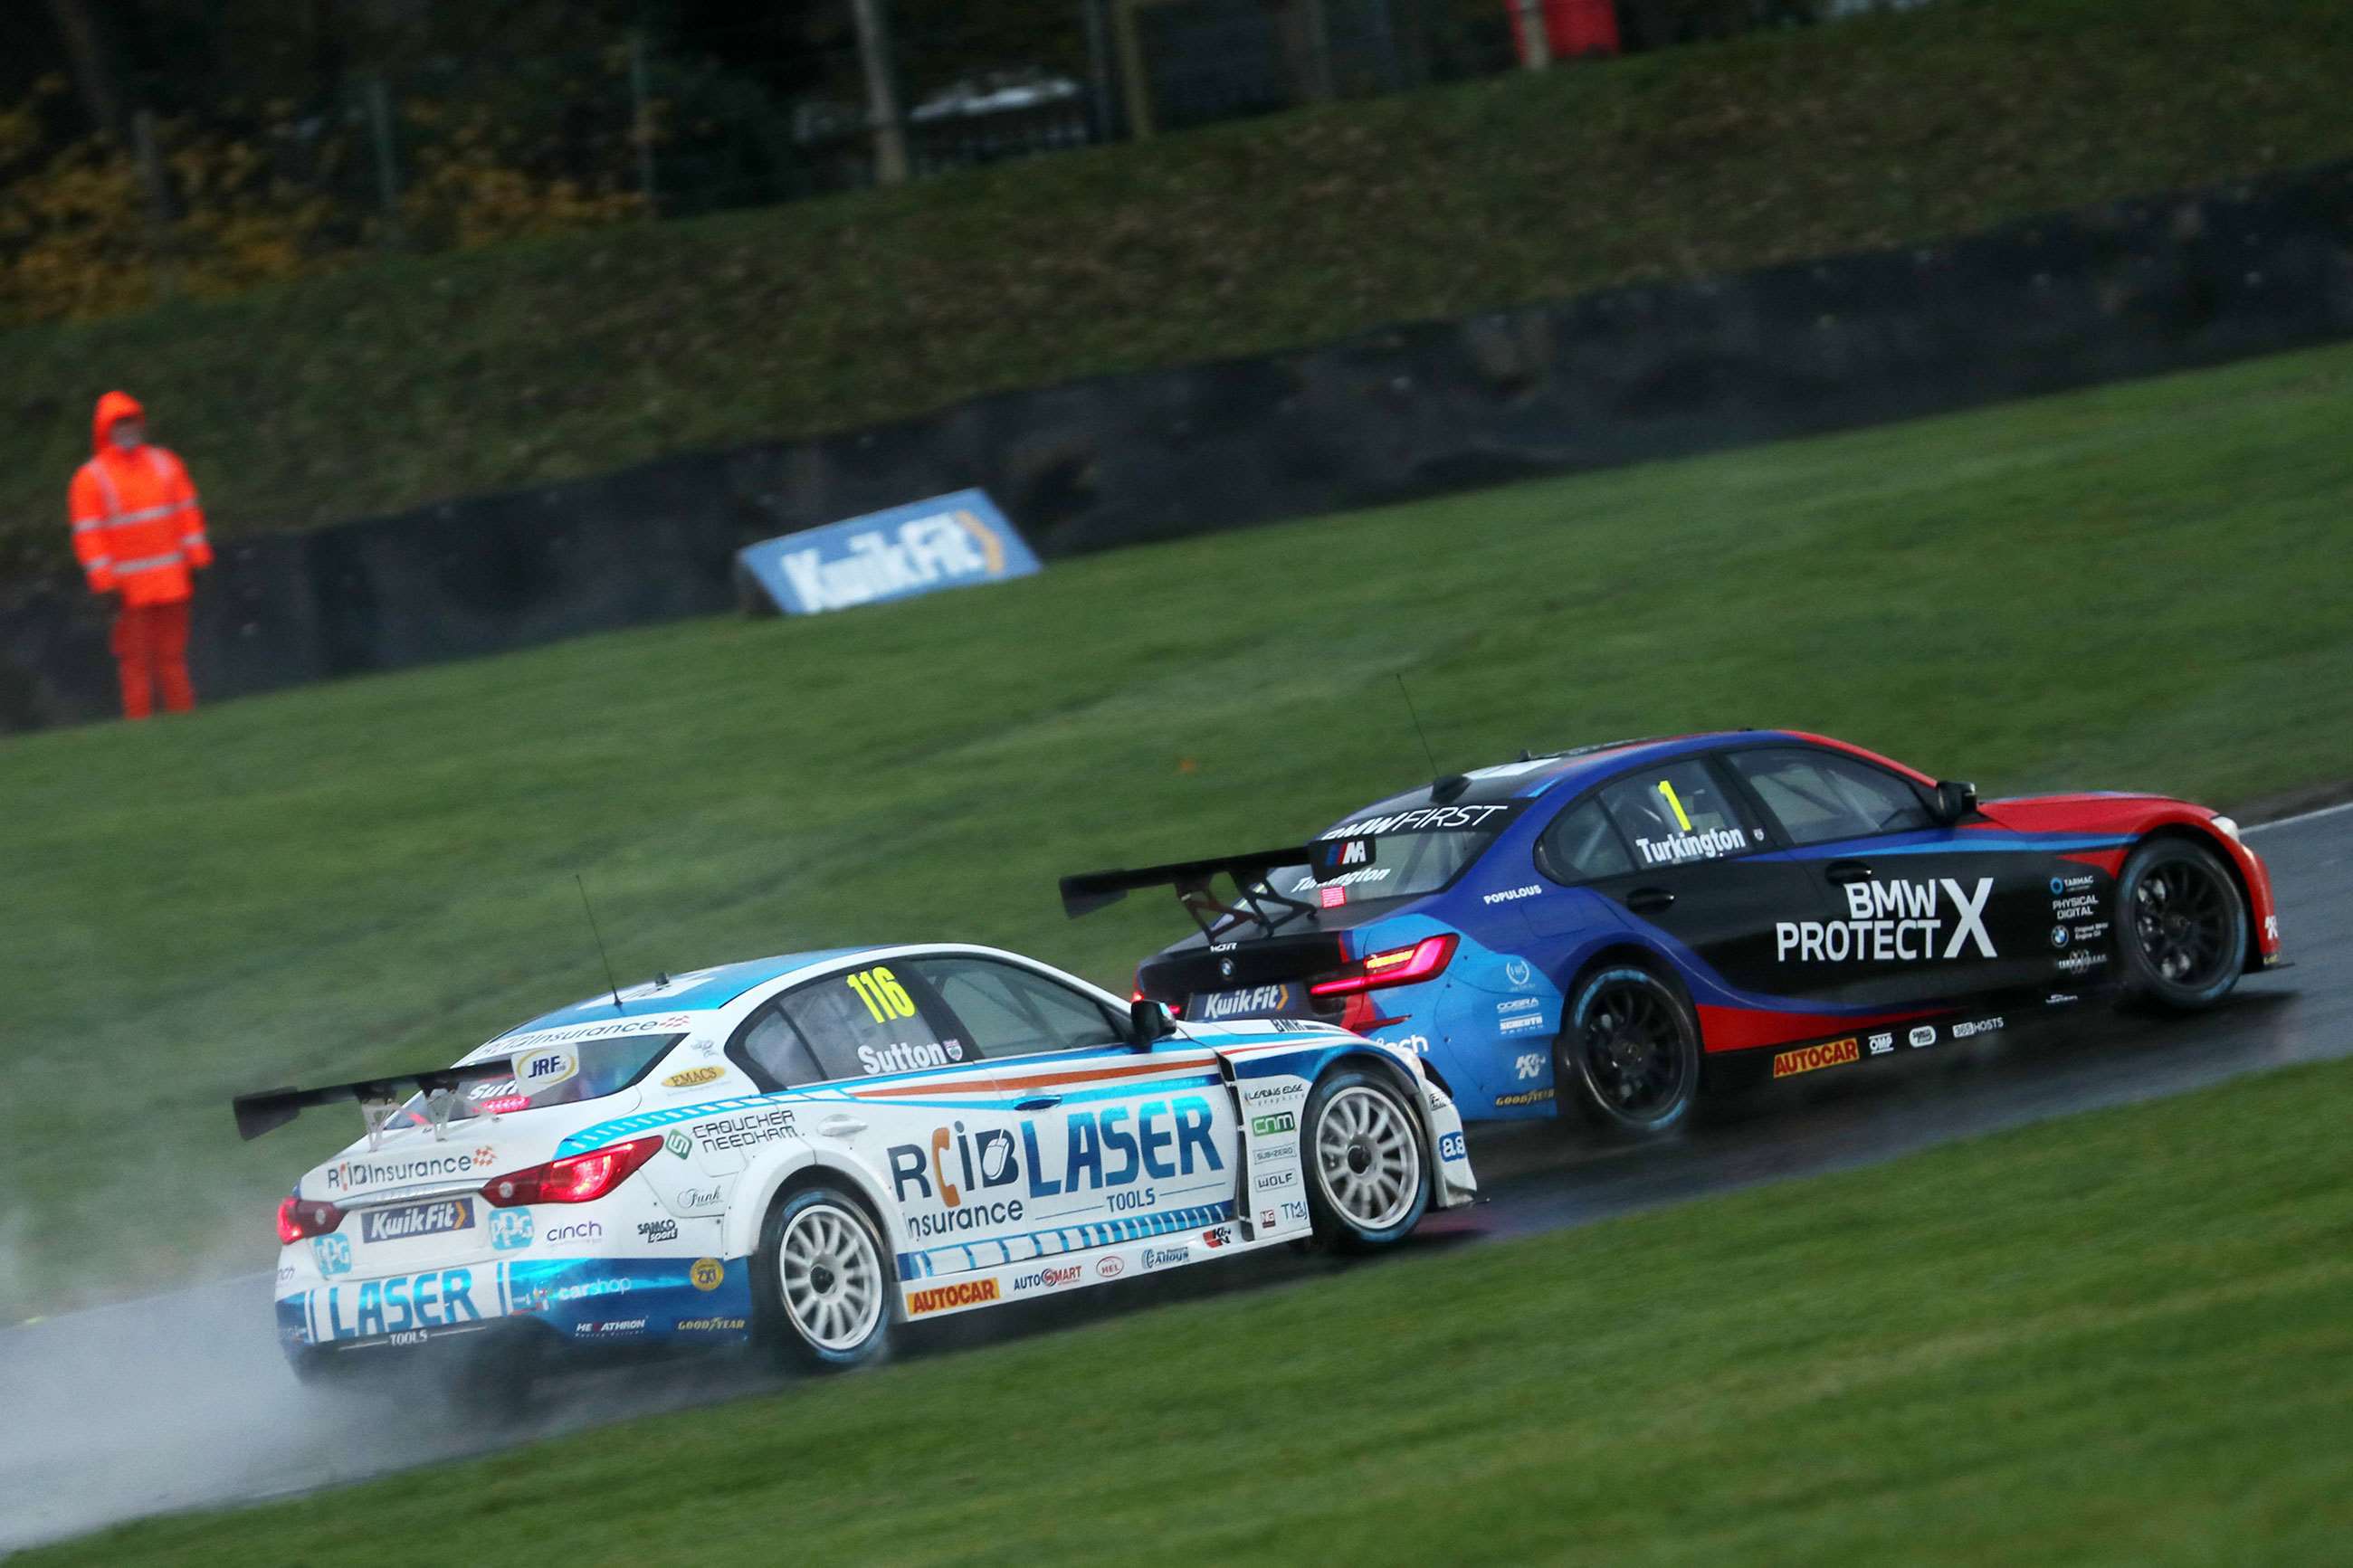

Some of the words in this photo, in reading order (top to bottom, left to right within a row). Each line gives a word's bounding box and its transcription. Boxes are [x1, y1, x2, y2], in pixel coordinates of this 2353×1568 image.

[1658, 780, 1691, 831] 1
[1635, 827, 1746, 863] Turkington
[1483, 884, 1543, 905] POPULOUS
[1843, 879, 1937, 919] BMW
[2053, 894, 2099, 910] PHYSICAL
[1939, 877, 1997, 958] X
[2056, 906, 2094, 920] DIGITAL
[1776, 919, 1941, 962] PROTECT
[846, 966, 916, 1024] 116
[1869, 1035, 1893, 1050] OMP
[528, 1055, 560, 1079] JRF
[857, 1041, 948, 1075] Sutton
[1775, 1040, 1858, 1076] AUTOCAR
[672, 1068, 719, 1087] EMACS
[692, 1109, 795, 1139] CROUCHER
[702, 1125, 798, 1153] NEEDHAM
[1020, 1097, 1224, 1200] LASER
[1258, 1173, 1293, 1188] WOLF
[1106, 1188, 1156, 1214] TOOLS
[547, 1221, 602, 1241] cinch
[637, 1219, 676, 1235] SAMCO
[559, 1278, 632, 1301] carshop
[913, 1279, 996, 1314] AUTOCAR
[329, 1268, 482, 1341] LASER
[390, 1329, 428, 1346] TOOLS
[679, 1317, 746, 1331] GOODYEAR
